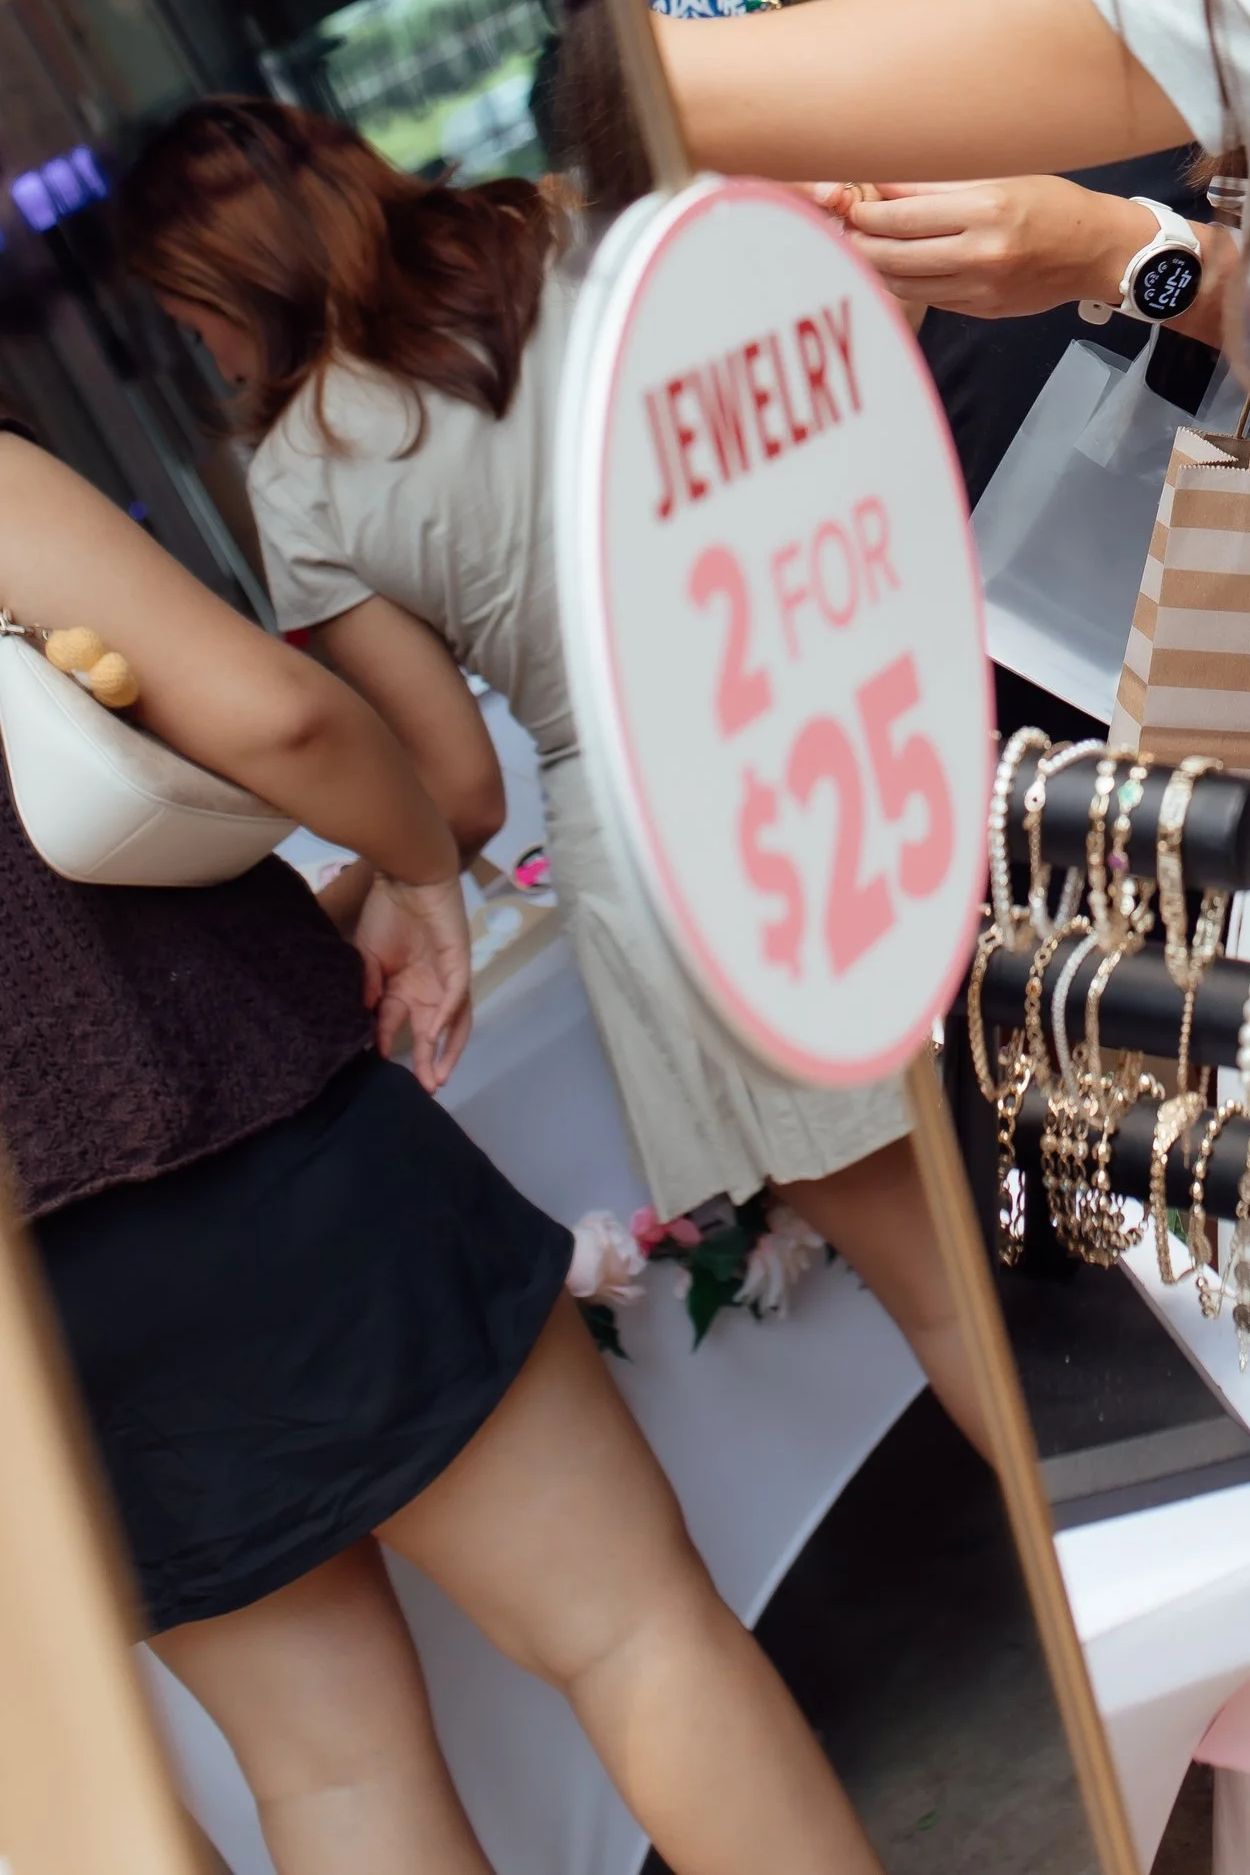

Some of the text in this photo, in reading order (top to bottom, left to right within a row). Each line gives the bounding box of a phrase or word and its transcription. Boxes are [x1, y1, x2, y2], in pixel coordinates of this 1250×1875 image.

[1159, 285, 1181, 307] 12
[1166, 267, 1192, 288] 47
[643, 297, 863, 522] JEWELRY
[687, 495, 901, 741] 2 FOR
[736, 650, 954, 982] $25
